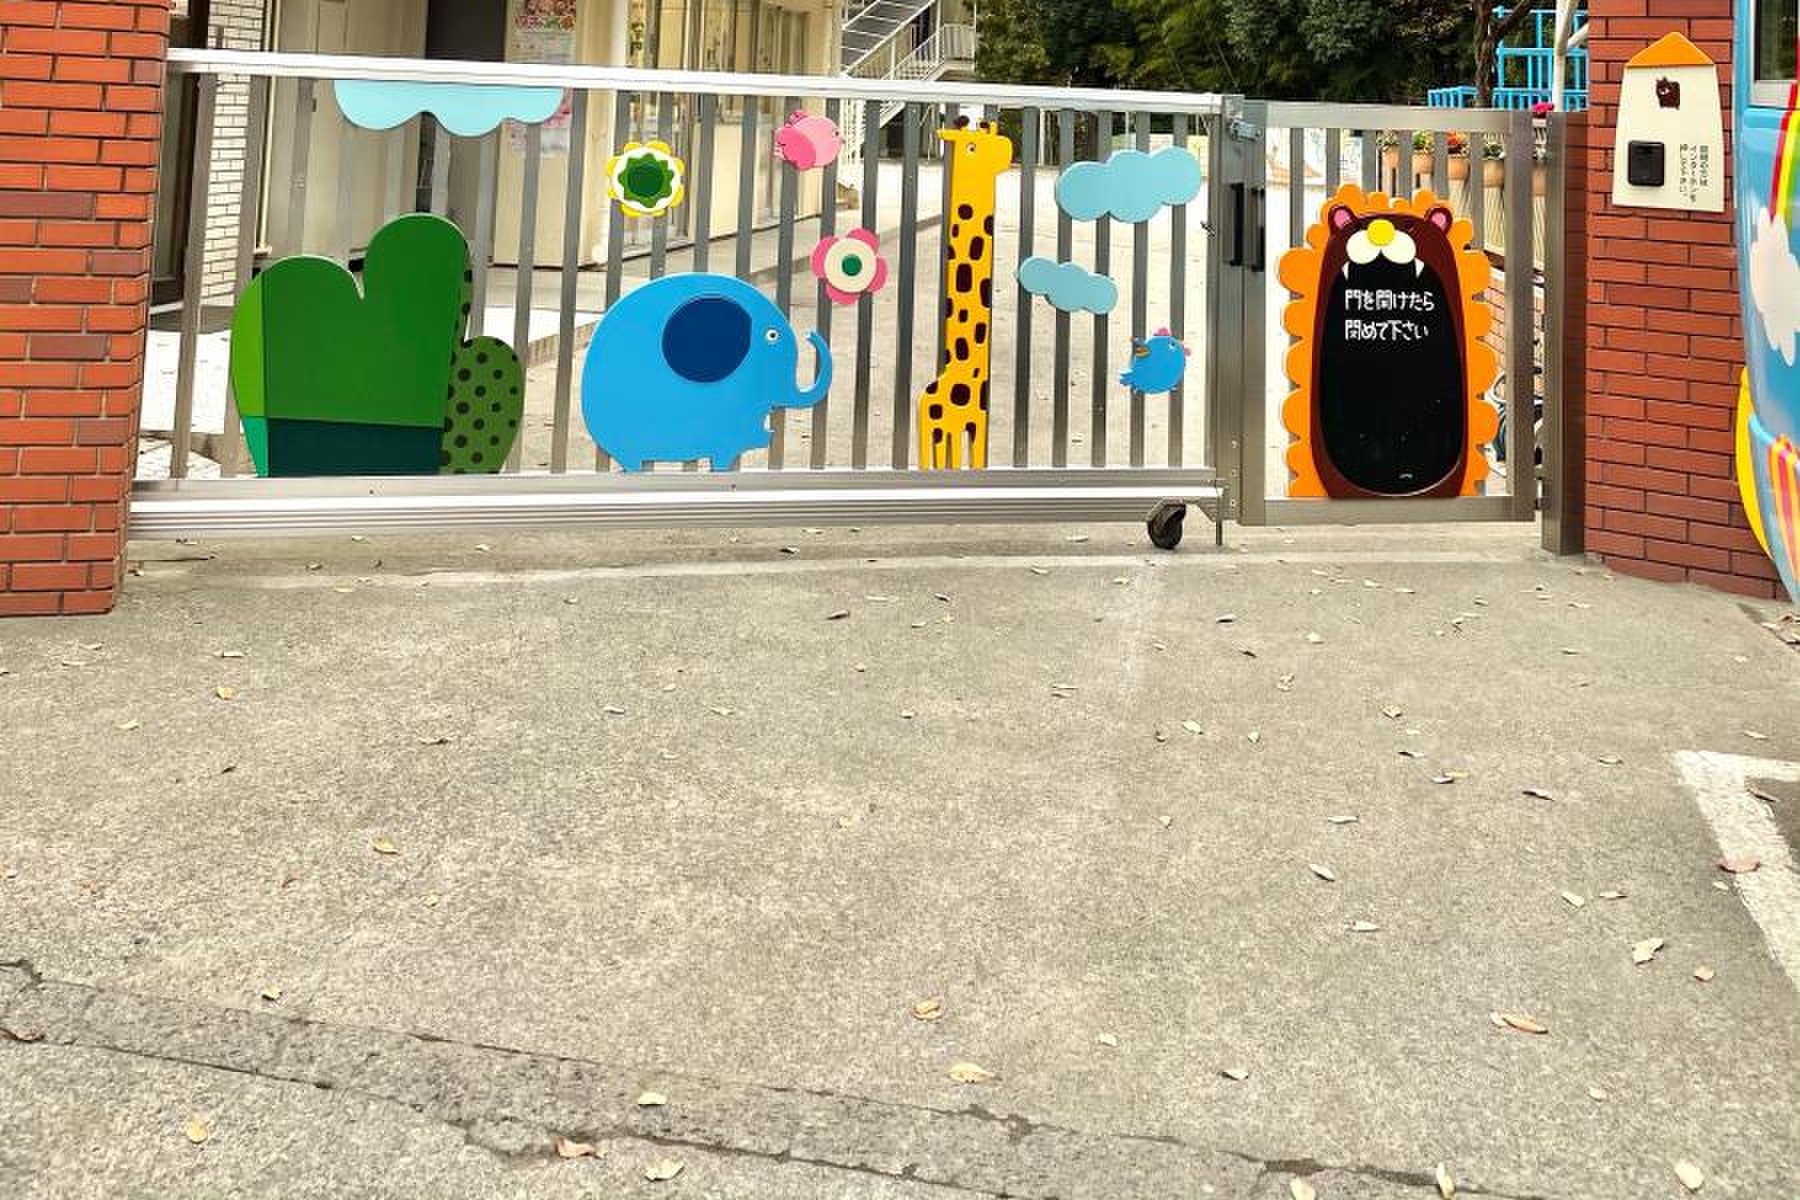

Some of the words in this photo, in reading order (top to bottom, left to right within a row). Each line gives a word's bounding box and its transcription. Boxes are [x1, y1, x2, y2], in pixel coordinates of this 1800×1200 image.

[1345, 289, 1434, 311] 門を開けたら
[1345, 319, 1429, 341] 閉めて下さい
